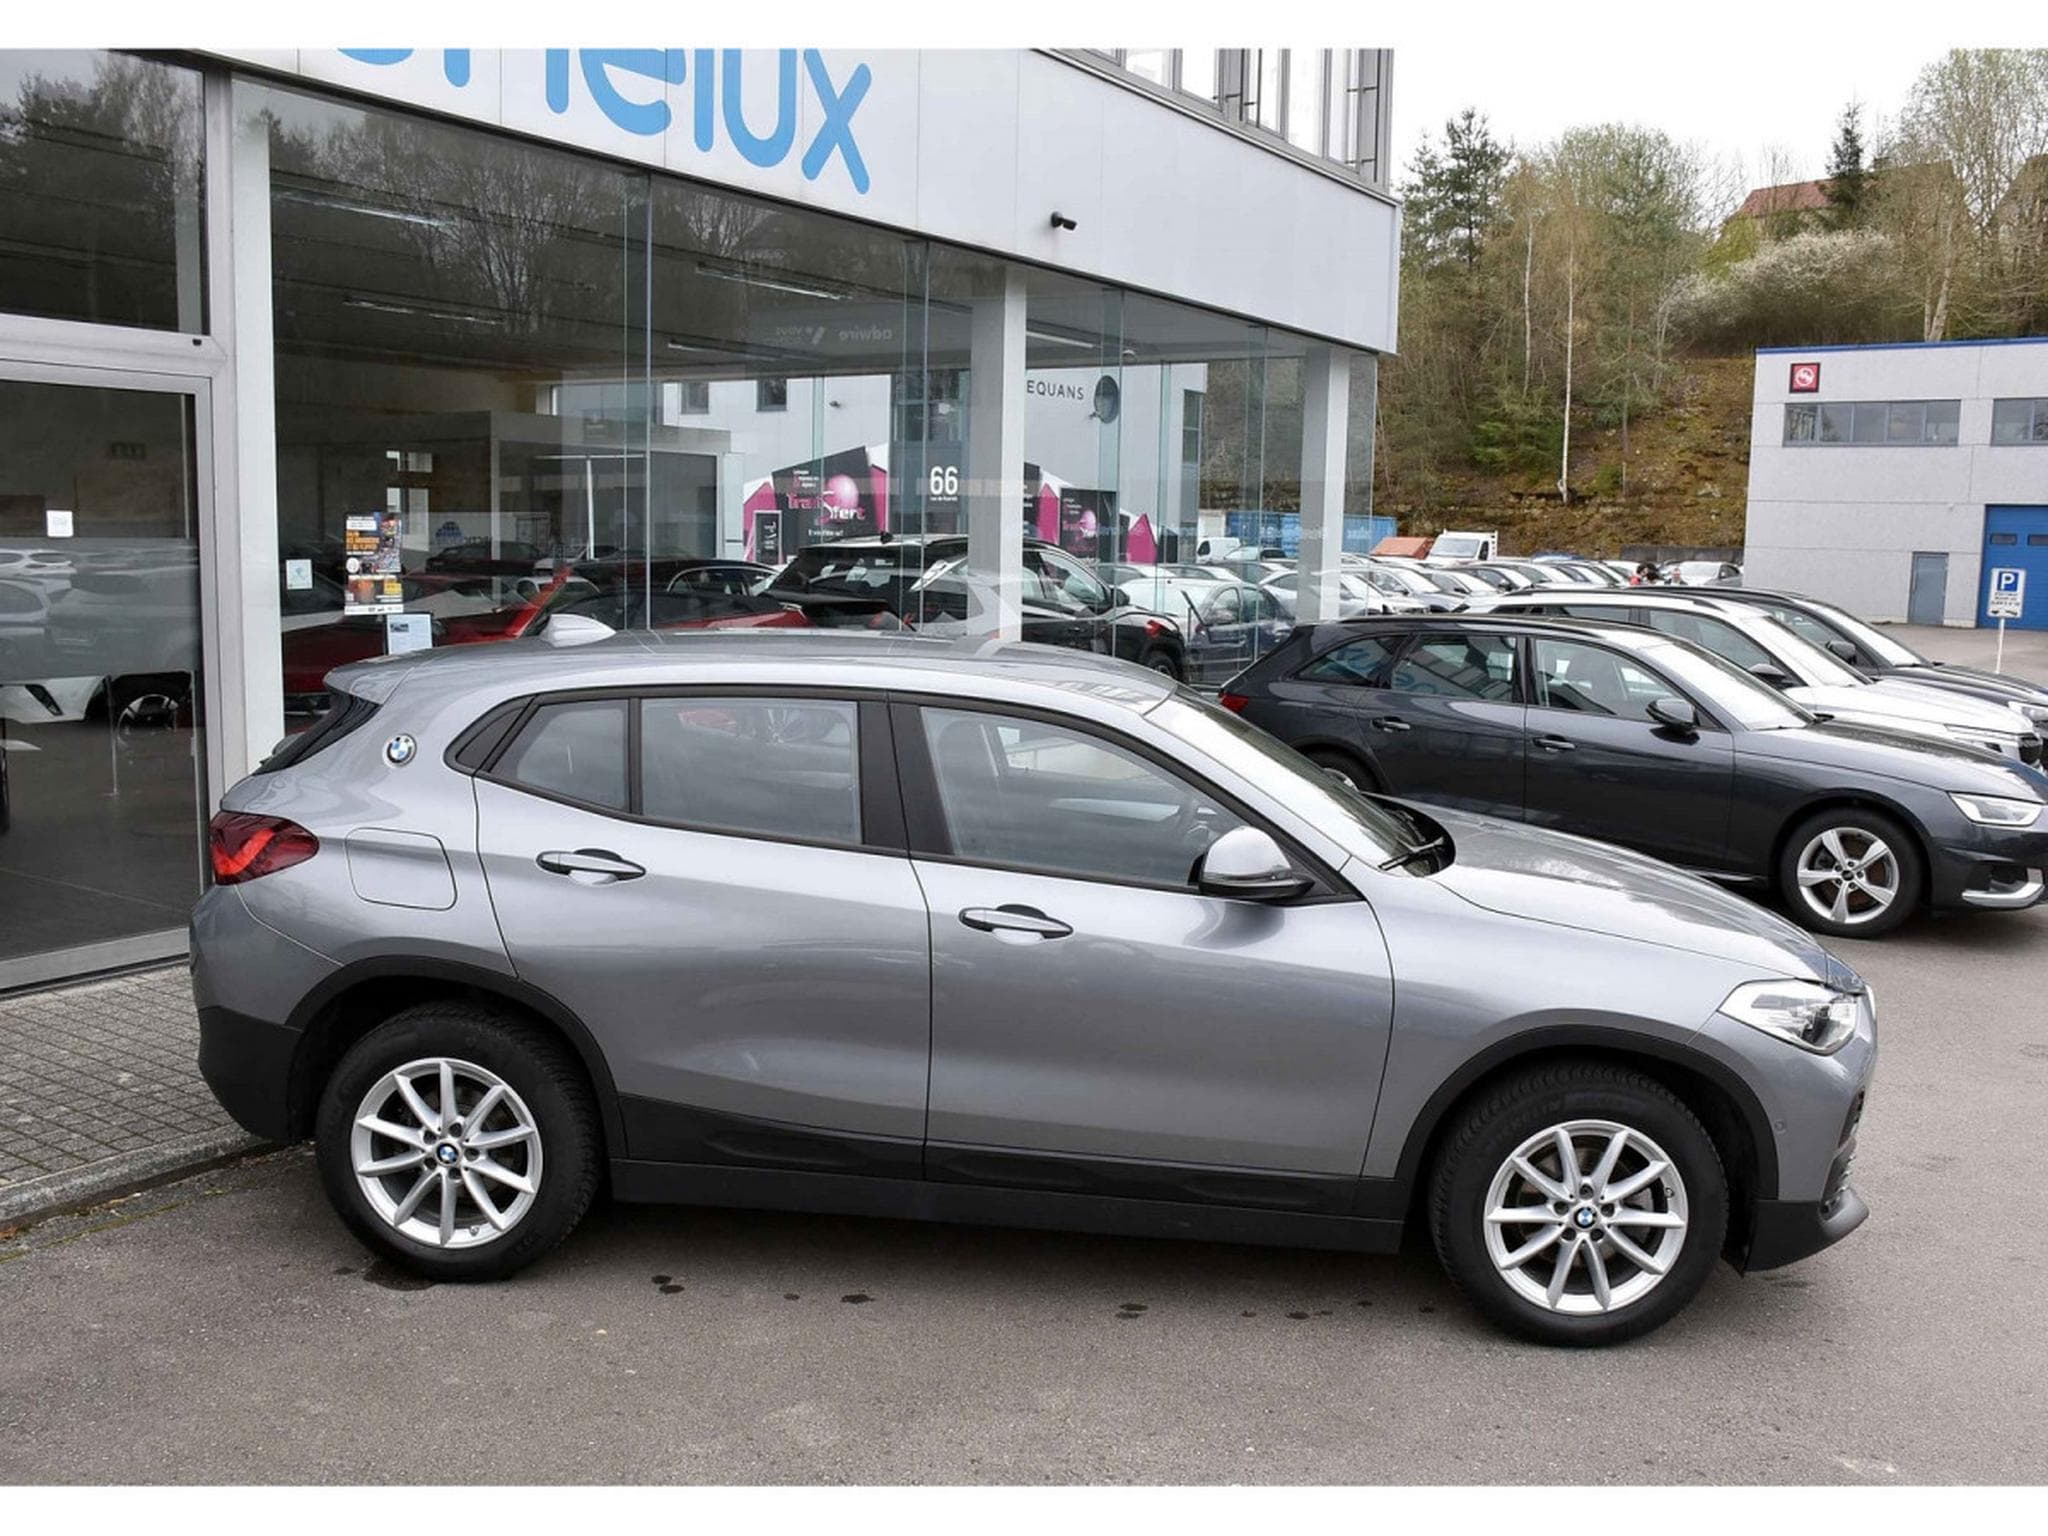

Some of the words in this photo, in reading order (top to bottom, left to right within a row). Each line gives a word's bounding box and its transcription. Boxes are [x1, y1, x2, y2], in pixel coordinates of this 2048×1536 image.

[1026, 379, 1085, 401] EQUANS
[930, 466, 958, 495] 66
[2001, 573, 2016, 590] P
